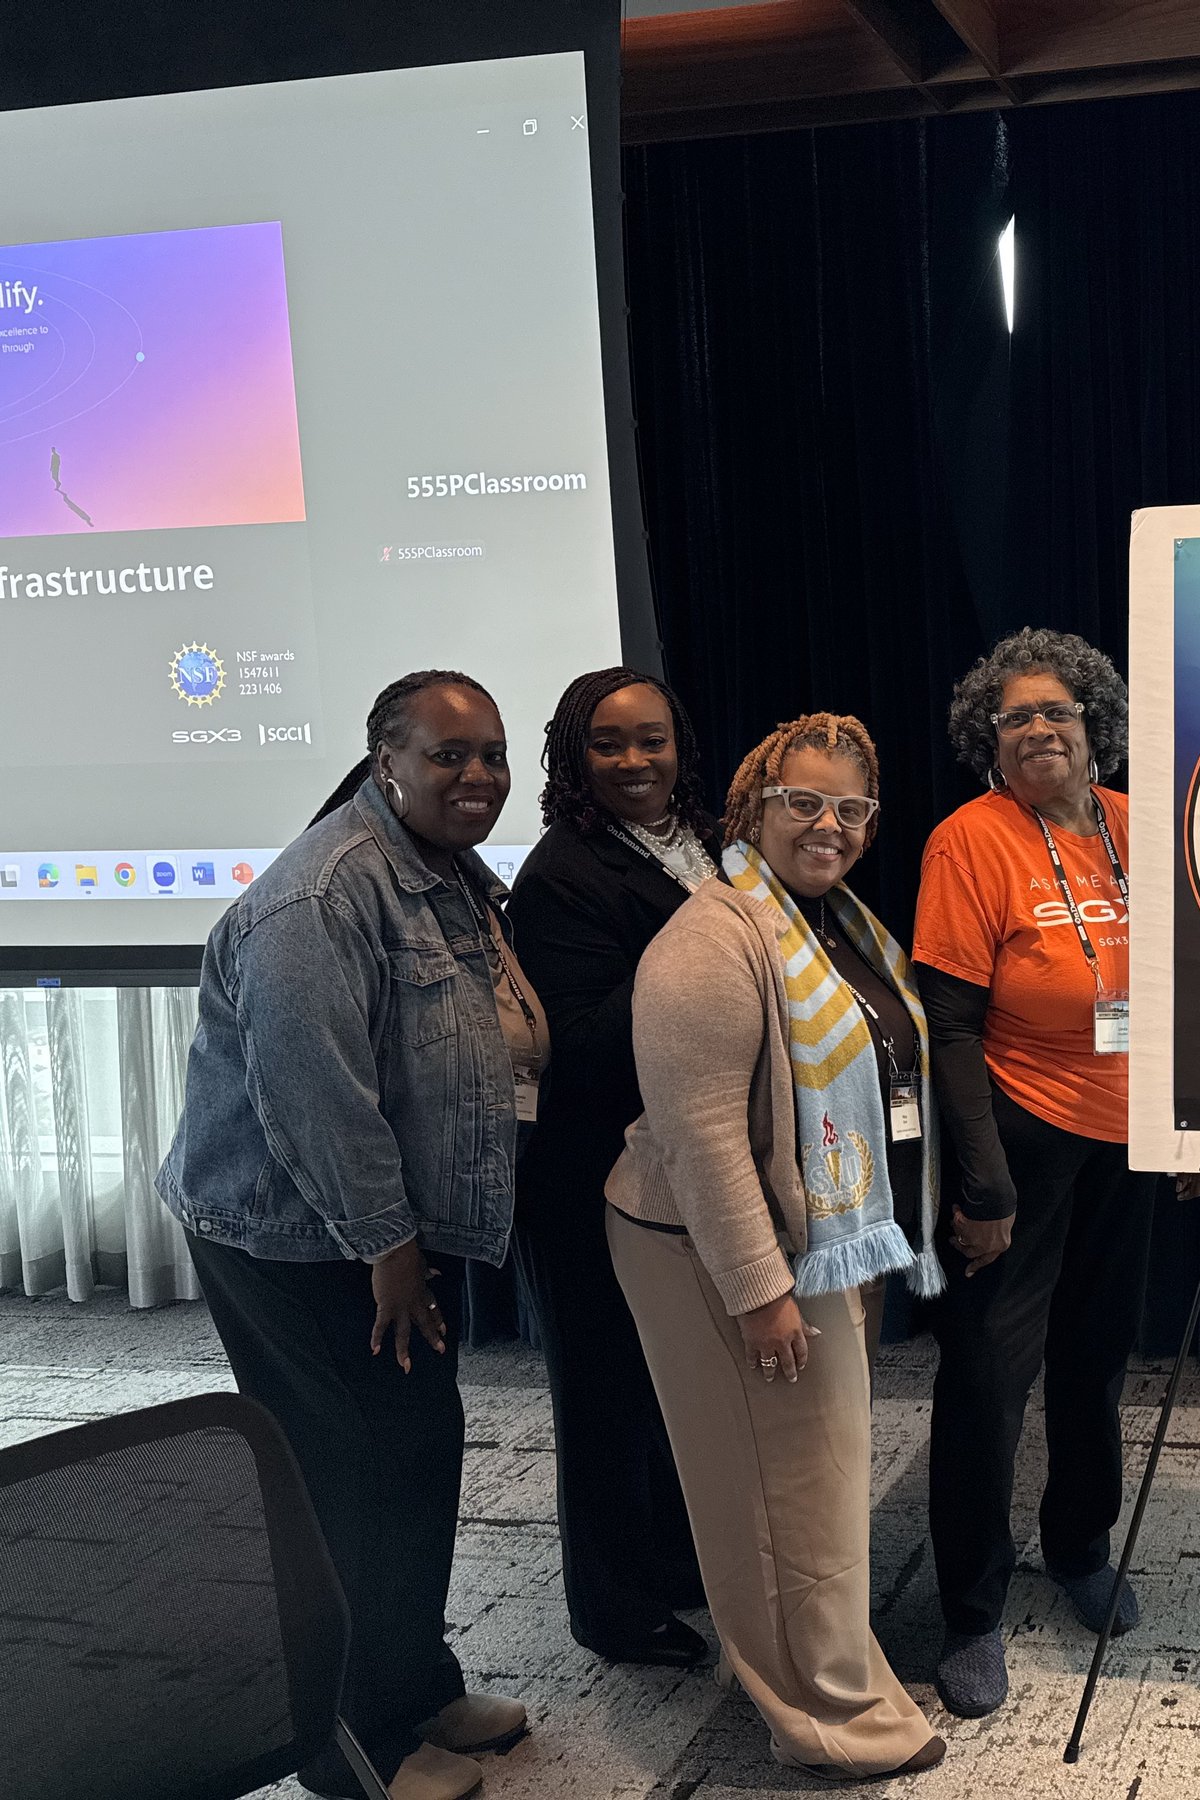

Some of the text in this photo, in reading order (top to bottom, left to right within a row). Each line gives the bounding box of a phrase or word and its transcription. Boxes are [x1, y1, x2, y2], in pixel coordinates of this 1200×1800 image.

[40, 326, 49, 335] to
[2, 341, 35, 354] through
[407, 472, 587, 498] 555PClassroom
[398, 546, 482, 560] 555PClassroom
[0, 563, 214, 599] frastructure
[236, 650, 295, 662] NSF awards
[178, 666, 217, 684] NSF
[239, 666, 279, 679] 1547611
[239, 683, 282, 695] 2231406
[172, 728, 242, 743] SGX3
[607, 824, 651, 859] OnDemand
[1098, 821, 1119, 865] OnDemand
[1075, 874, 1101, 888] ME
[1060, 879, 1082, 925] OnDemand
